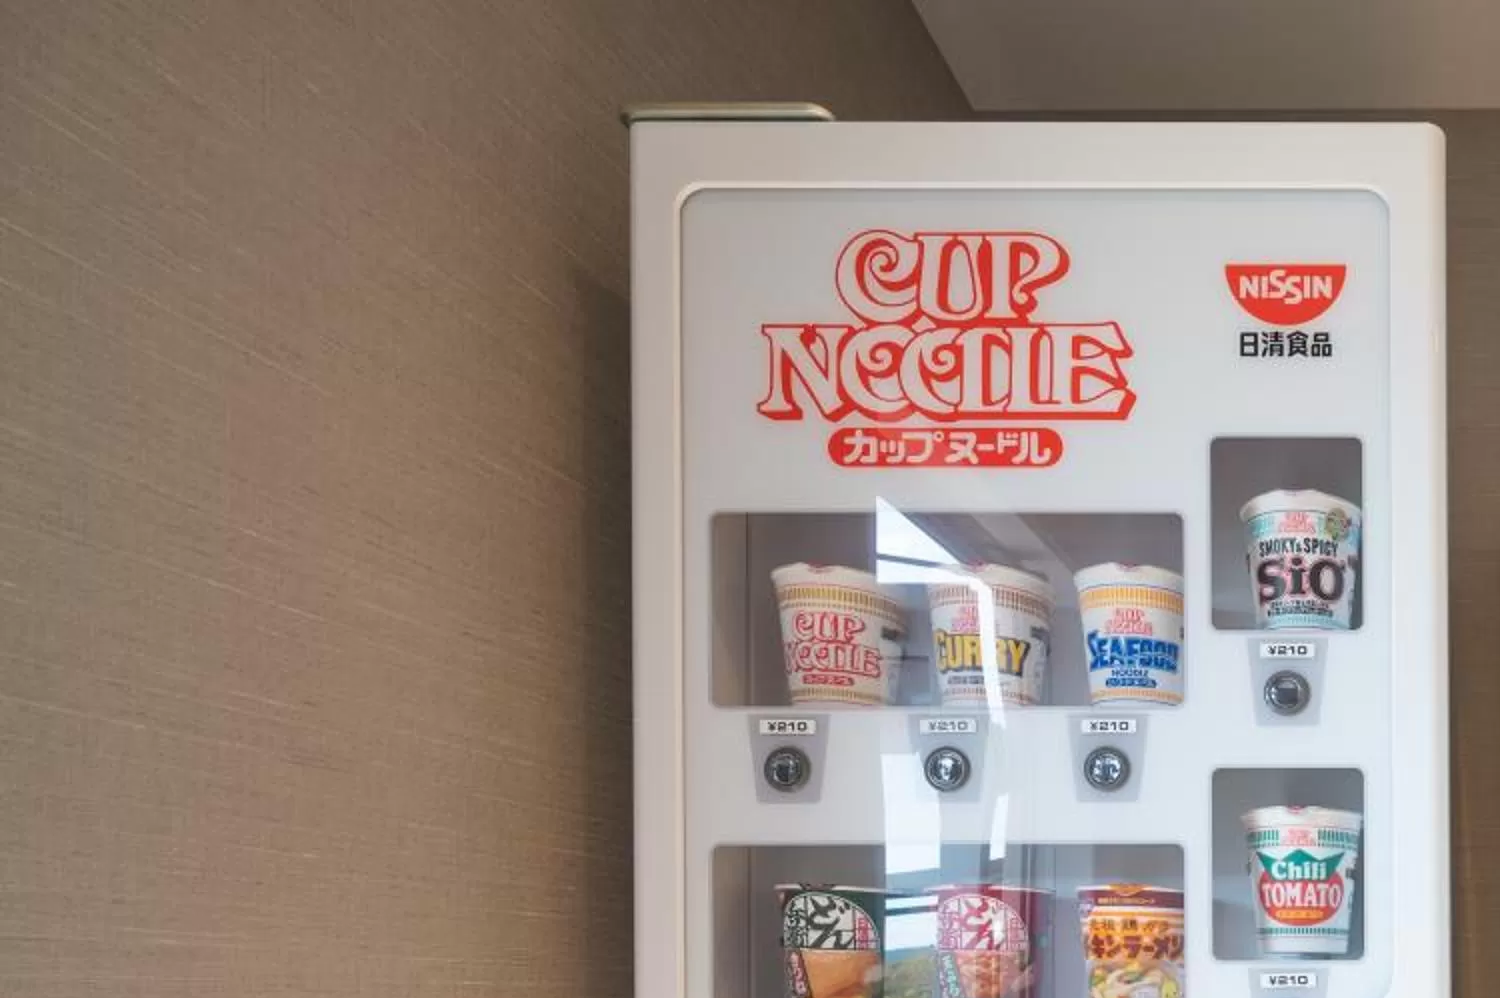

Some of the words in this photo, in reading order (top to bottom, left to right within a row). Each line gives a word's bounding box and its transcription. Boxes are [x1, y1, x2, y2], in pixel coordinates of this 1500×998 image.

[835, 229, 1070, 323] CUP
[1239, 272, 1334, 304] NISSIN
[1239, 332, 1333, 358] 日清食品
[757, 321, 1137, 421] NOODLE
[841, 429, 1053, 465] カップヌードル
[793, 610, 865, 642] CUP
[785, 641, 881, 678] NOODLE
[1087, 630, 1180, 674] SEAFOOD
[1268, 646, 1308, 655] ¥210
[767, 721, 808, 731] ¥210
[928, 721, 969, 731] ¥210
[1089, 721, 1130, 731] ¥210
[1271, 861, 1327, 880] Chili
[1261, 881, 1341, 908] TOMATO
[1269, 975, 1309, 985] ¥210
